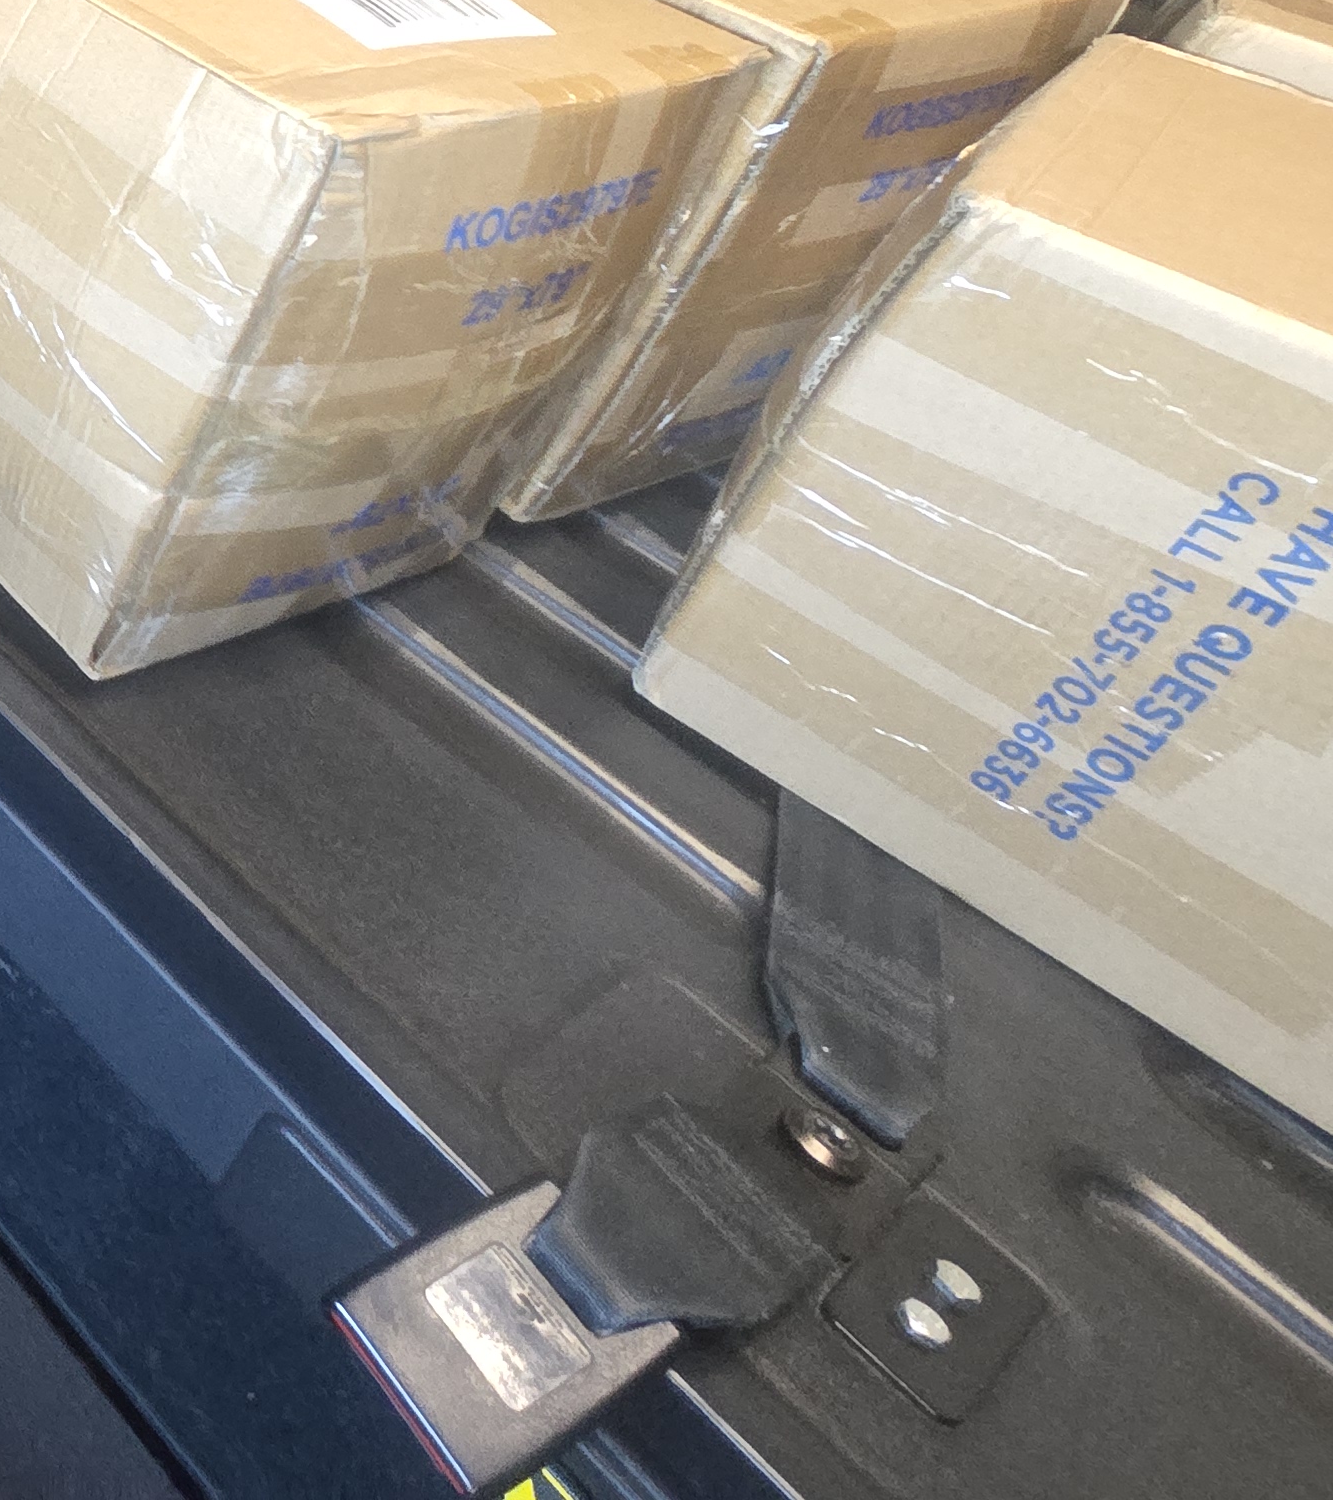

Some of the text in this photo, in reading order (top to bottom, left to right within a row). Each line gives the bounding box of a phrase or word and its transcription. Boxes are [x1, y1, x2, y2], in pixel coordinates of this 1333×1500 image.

[969, 471, 1280, 800] CALL 1-855-702-6636
[1033, 507, 1333, 840] HAVE QUESTIONS?
